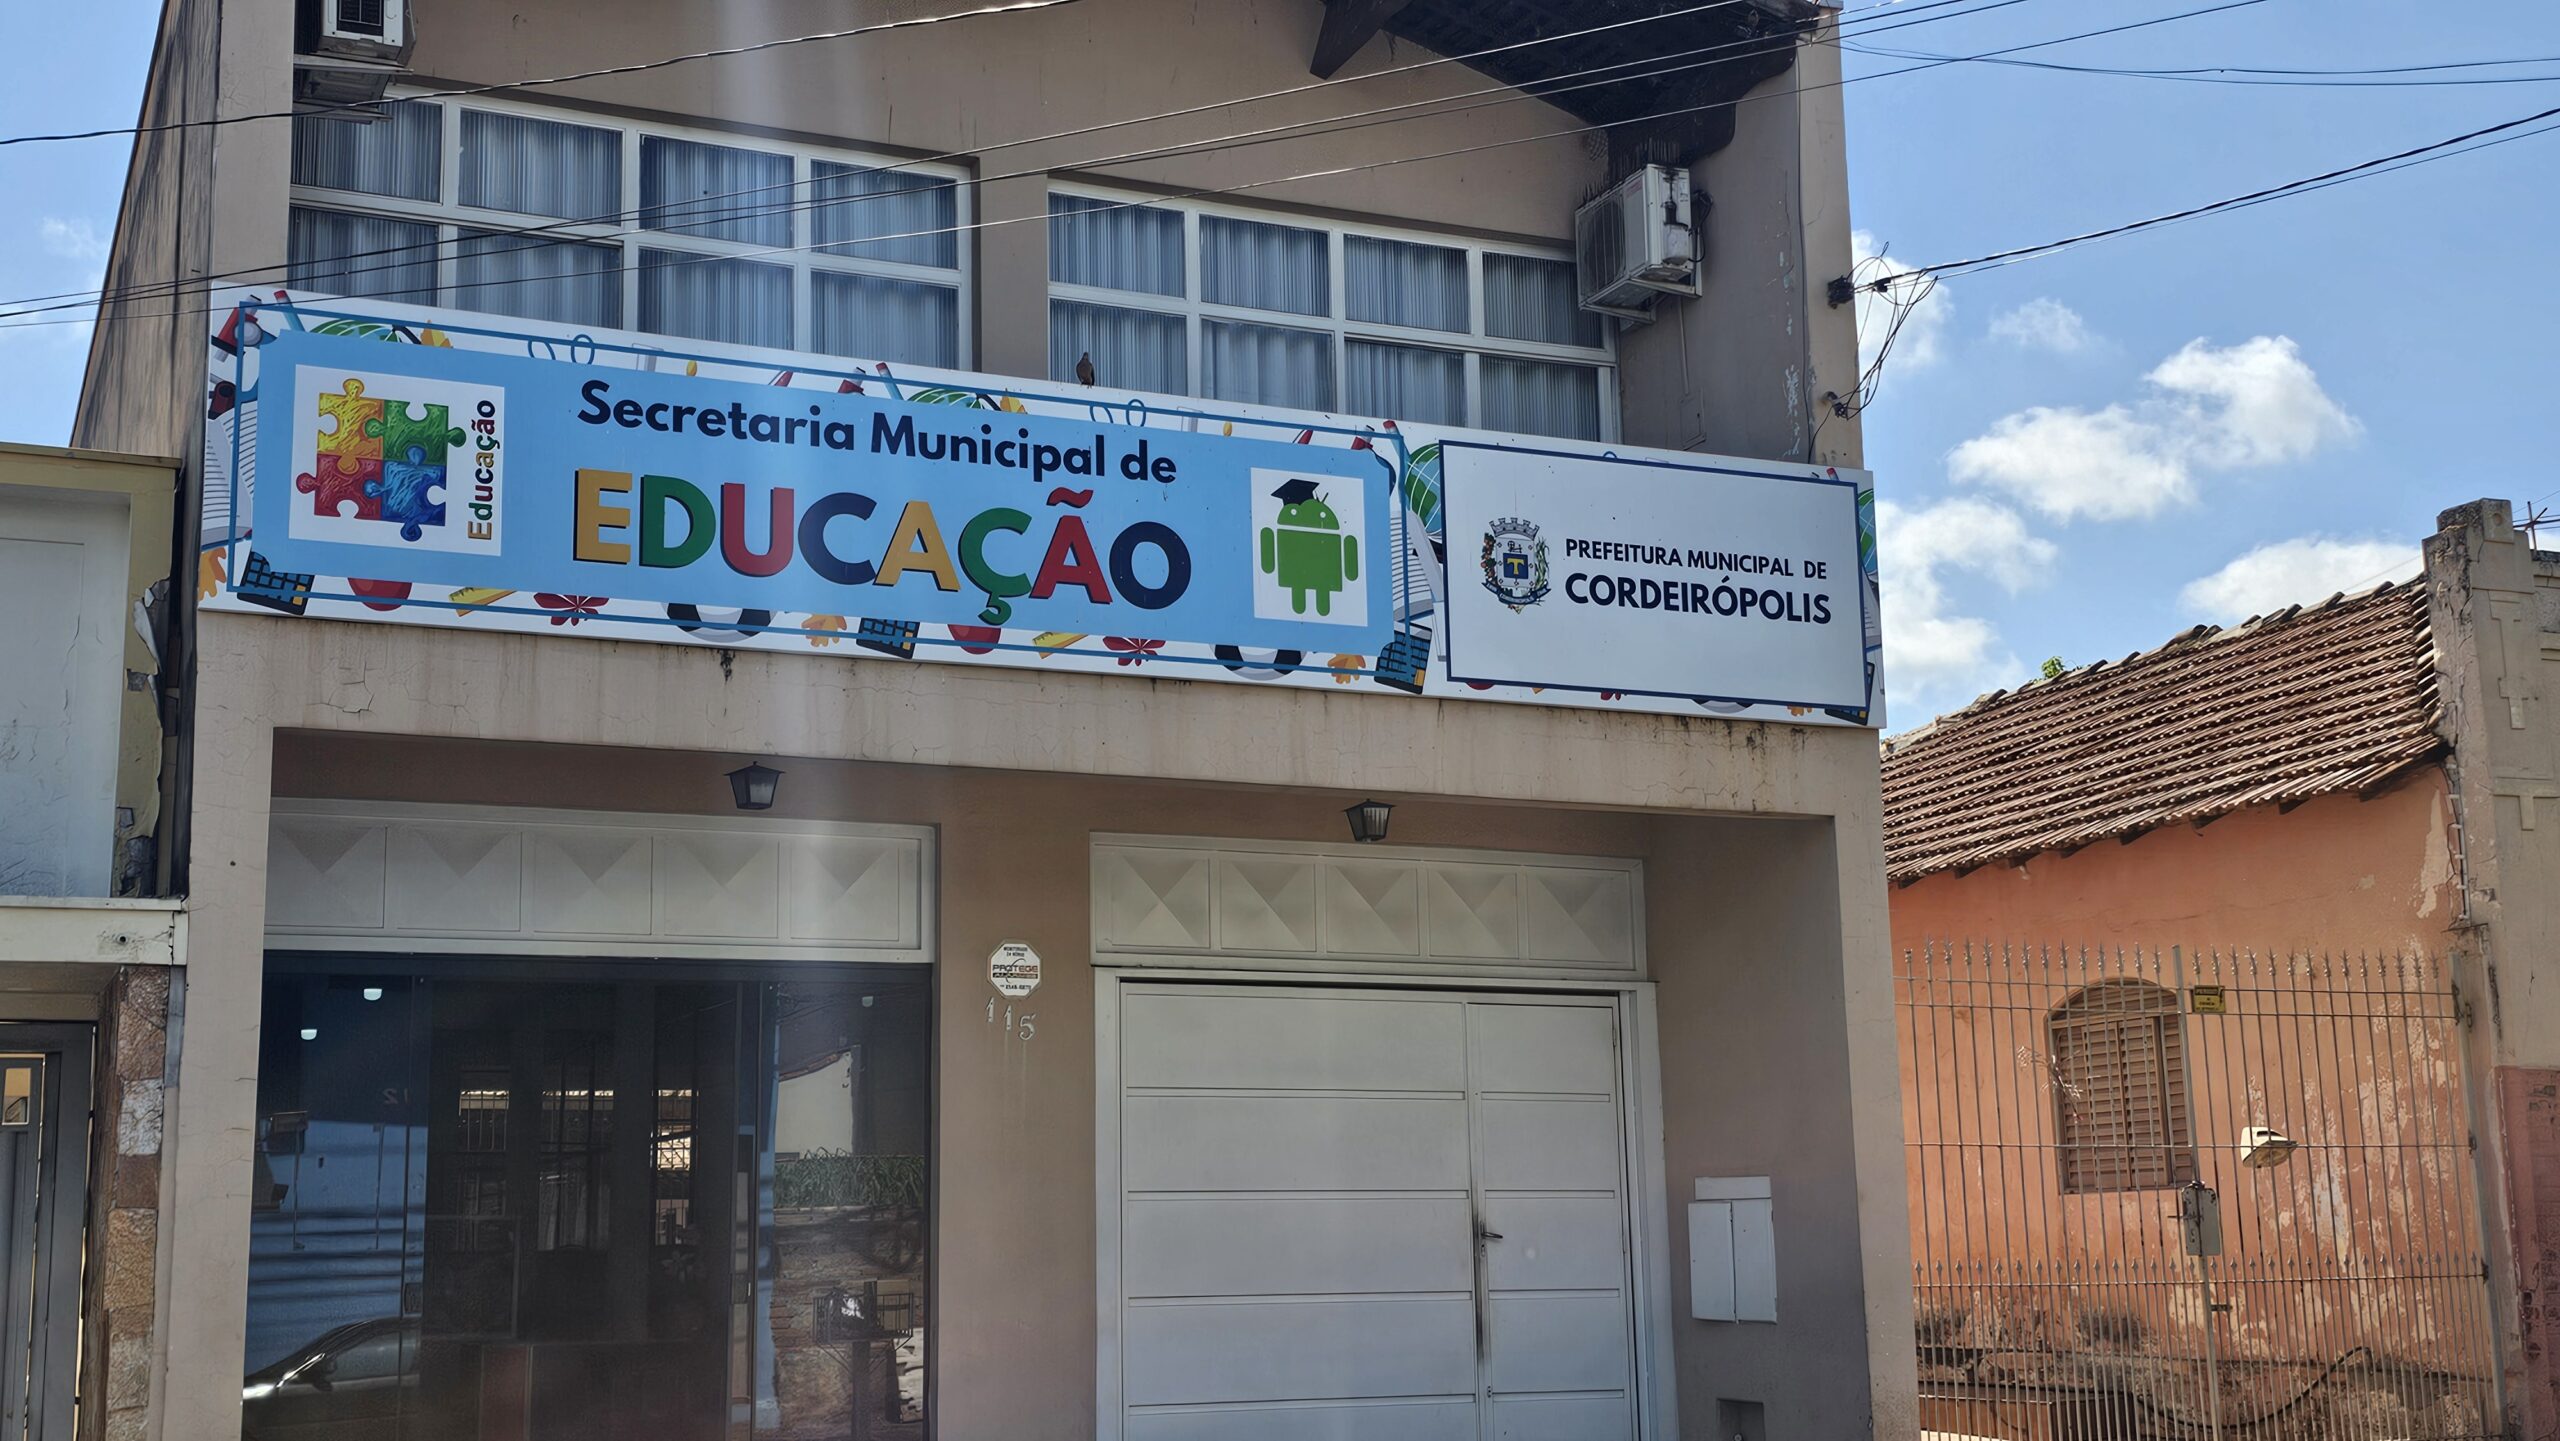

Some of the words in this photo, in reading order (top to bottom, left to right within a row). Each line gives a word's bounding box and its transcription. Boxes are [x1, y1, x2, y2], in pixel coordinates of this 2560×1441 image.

[467, 399, 497, 541] Educação
[577, 379, 855, 452] Secretaria
[871, 411, 1106, 483] Municipal
[1121, 438, 1177, 484] de
[573, 468, 1192, 626] EDUCAÇÃO
[1565, 538, 1683, 567] PREFEITURA
[1687, 549, 1795, 577] MUNICIPAL
[1804, 560, 1827, 580] DE
[1565, 573, 1832, 625] CORDEIRÓPOLIS
[986, 997, 1036, 1041] 115
